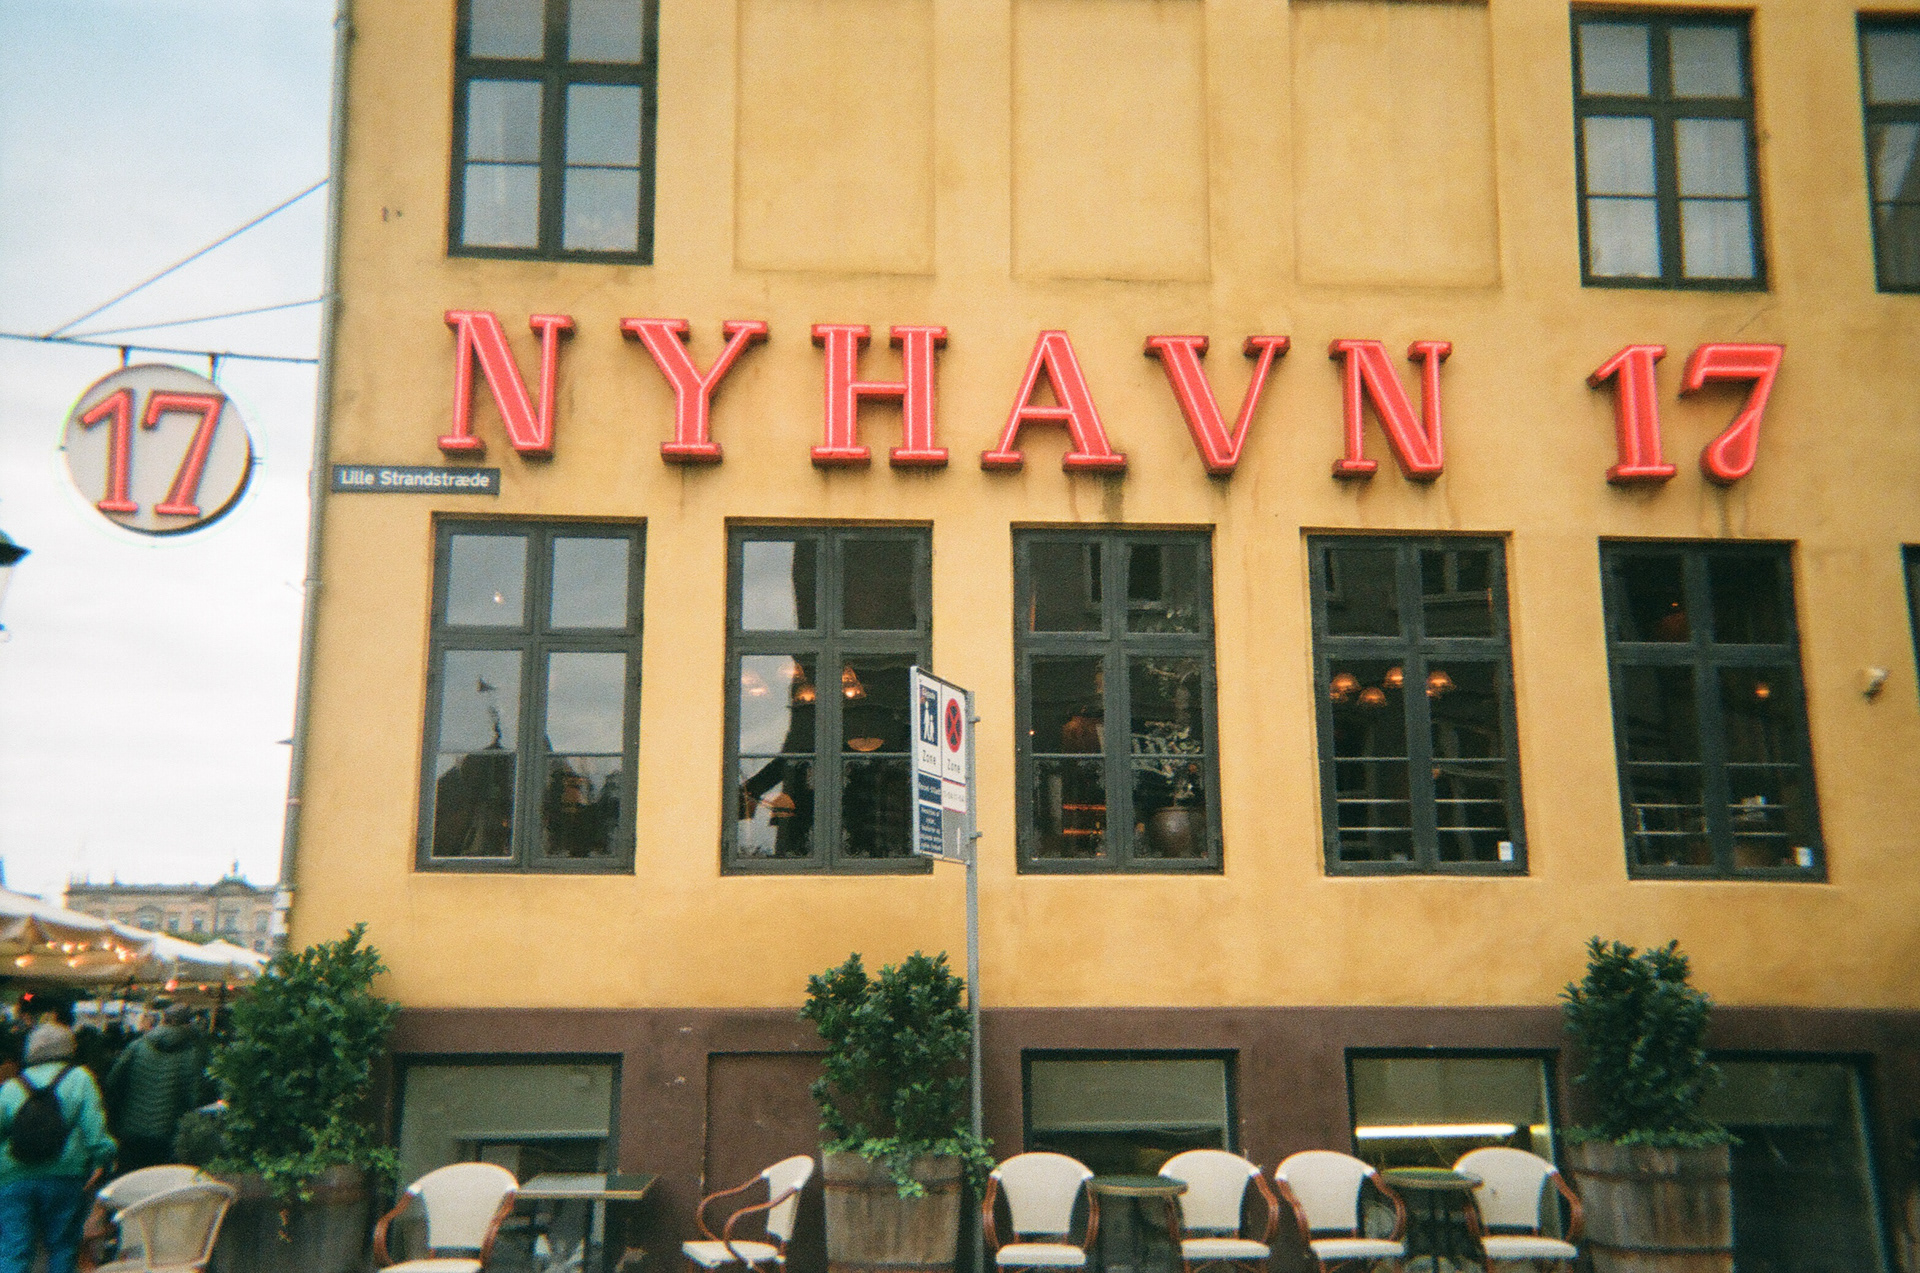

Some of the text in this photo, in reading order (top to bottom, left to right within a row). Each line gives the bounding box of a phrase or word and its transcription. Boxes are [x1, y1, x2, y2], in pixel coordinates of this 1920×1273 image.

[79, 387, 225, 516] 17
[437, 310, 1786, 486] NYHAVN 17
[341, 469, 491, 487] Lille Strandstræde
